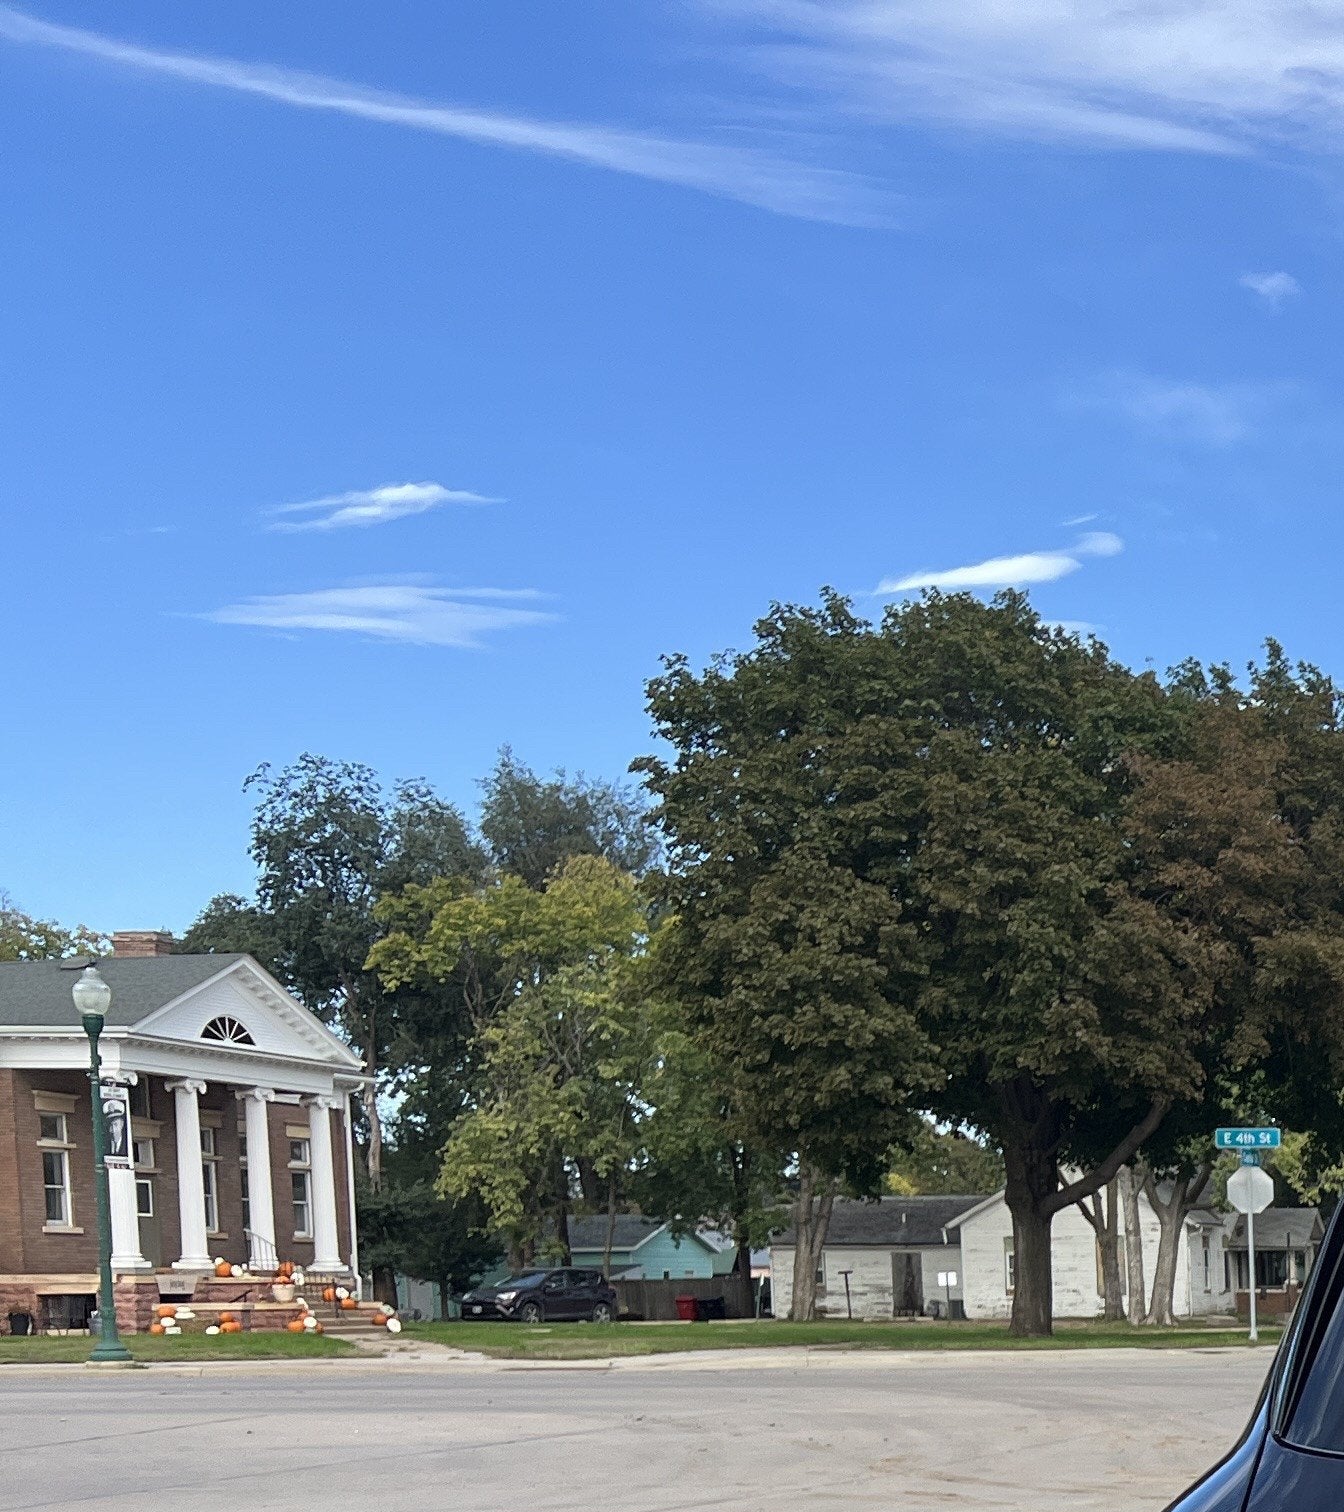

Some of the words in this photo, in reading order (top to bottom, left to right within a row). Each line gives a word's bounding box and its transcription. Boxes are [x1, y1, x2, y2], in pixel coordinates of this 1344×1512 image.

[1223, 1132, 1232, 1144] E
[1235, 1132, 1255, 1144] 4th
[1259, 1132, 1271, 1144] St
